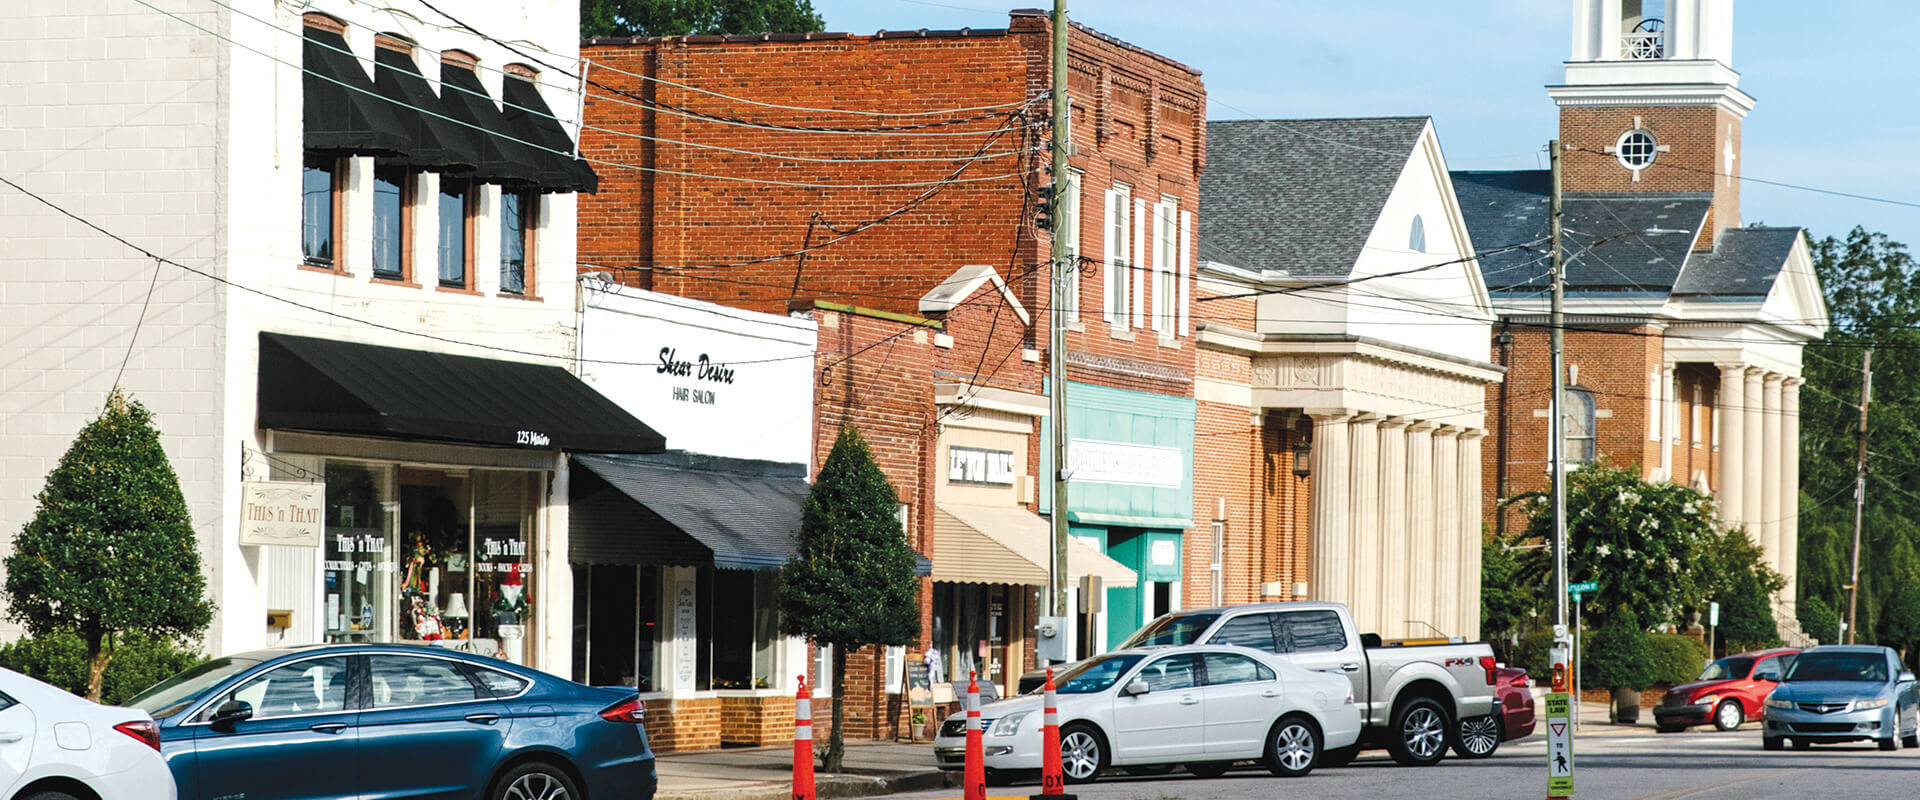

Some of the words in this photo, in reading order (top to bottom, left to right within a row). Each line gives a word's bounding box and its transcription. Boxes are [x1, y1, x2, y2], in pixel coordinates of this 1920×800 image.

[656, 346, 692, 377] Shear
[697, 353, 735, 385] Desire
[672, 386, 689, 402] HAIR
[692, 388, 716, 405] SALON
[516, 430, 530, 444] 125
[530, 431, 551, 446] Main
[1445, 656, 1474, 667] FX4
[1549, 706, 1566, 714] LAW
